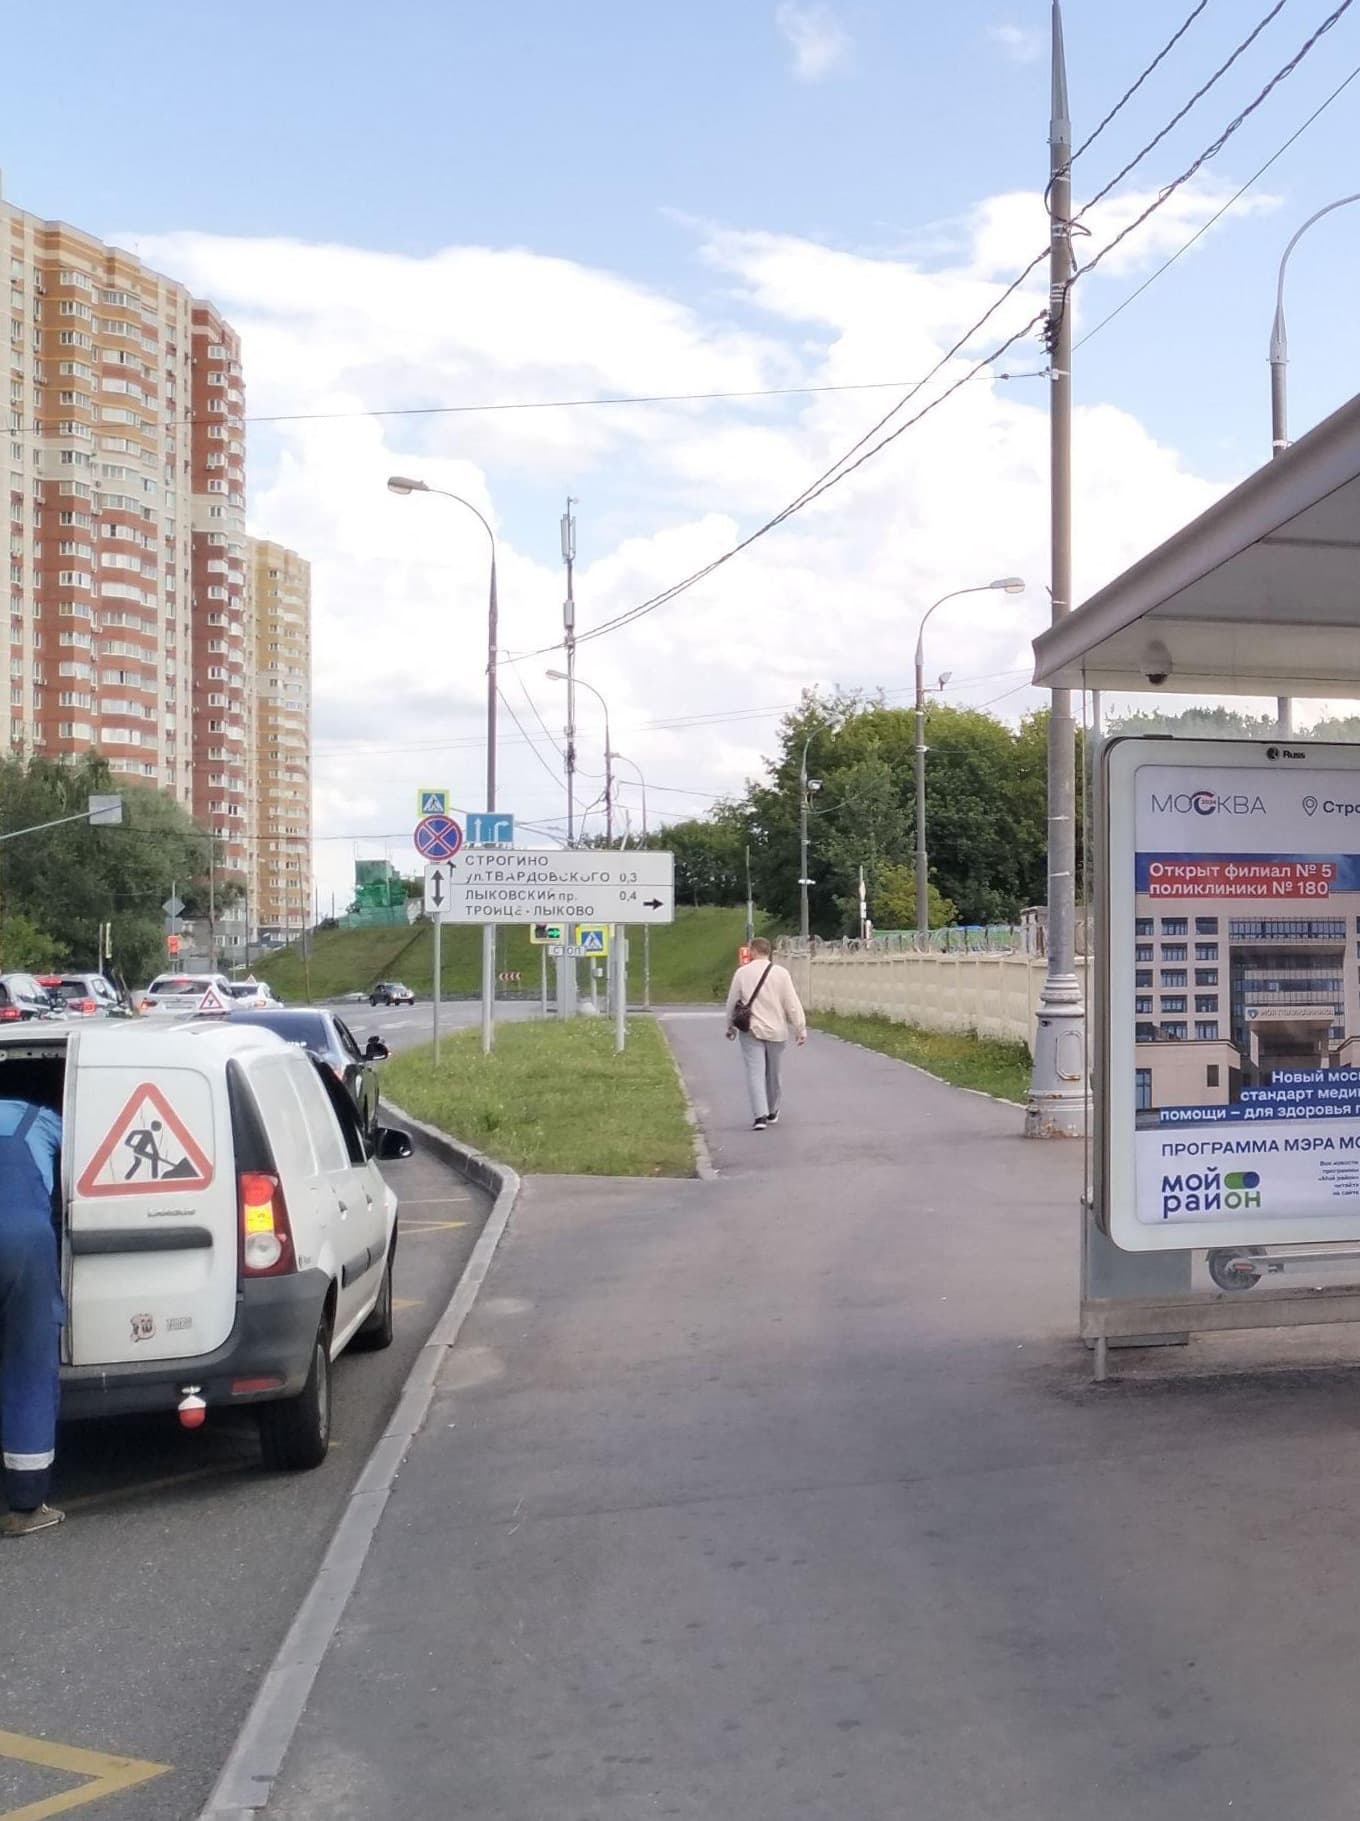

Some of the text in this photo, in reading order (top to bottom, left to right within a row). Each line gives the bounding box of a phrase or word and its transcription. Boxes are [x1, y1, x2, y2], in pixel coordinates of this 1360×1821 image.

[1151, 791, 1267, 816] МОСКВА
[465, 855, 549, 867] СТРОГИНО
[619, 872, 638, 884] 0,3
[1149, 862, 1332, 881] Открыт филиал № 5
[1149, 881, 1329, 895] поликлиники № 180
[619, 890, 637, 902] 0,4
[1271, 1069, 1324, 1084] Новый
[1240, 1089, 1314, 1102] стандарт
[1160, 1109, 1226, 1121] помощи
[1244, 1107, 1274, 1119] для
[1277, 1103, 1352, 1119] здоровья
[1161, 1139, 1280, 1157] ПРОГРАММА
[1284, 1136, 1336, 1152] МЭРА
